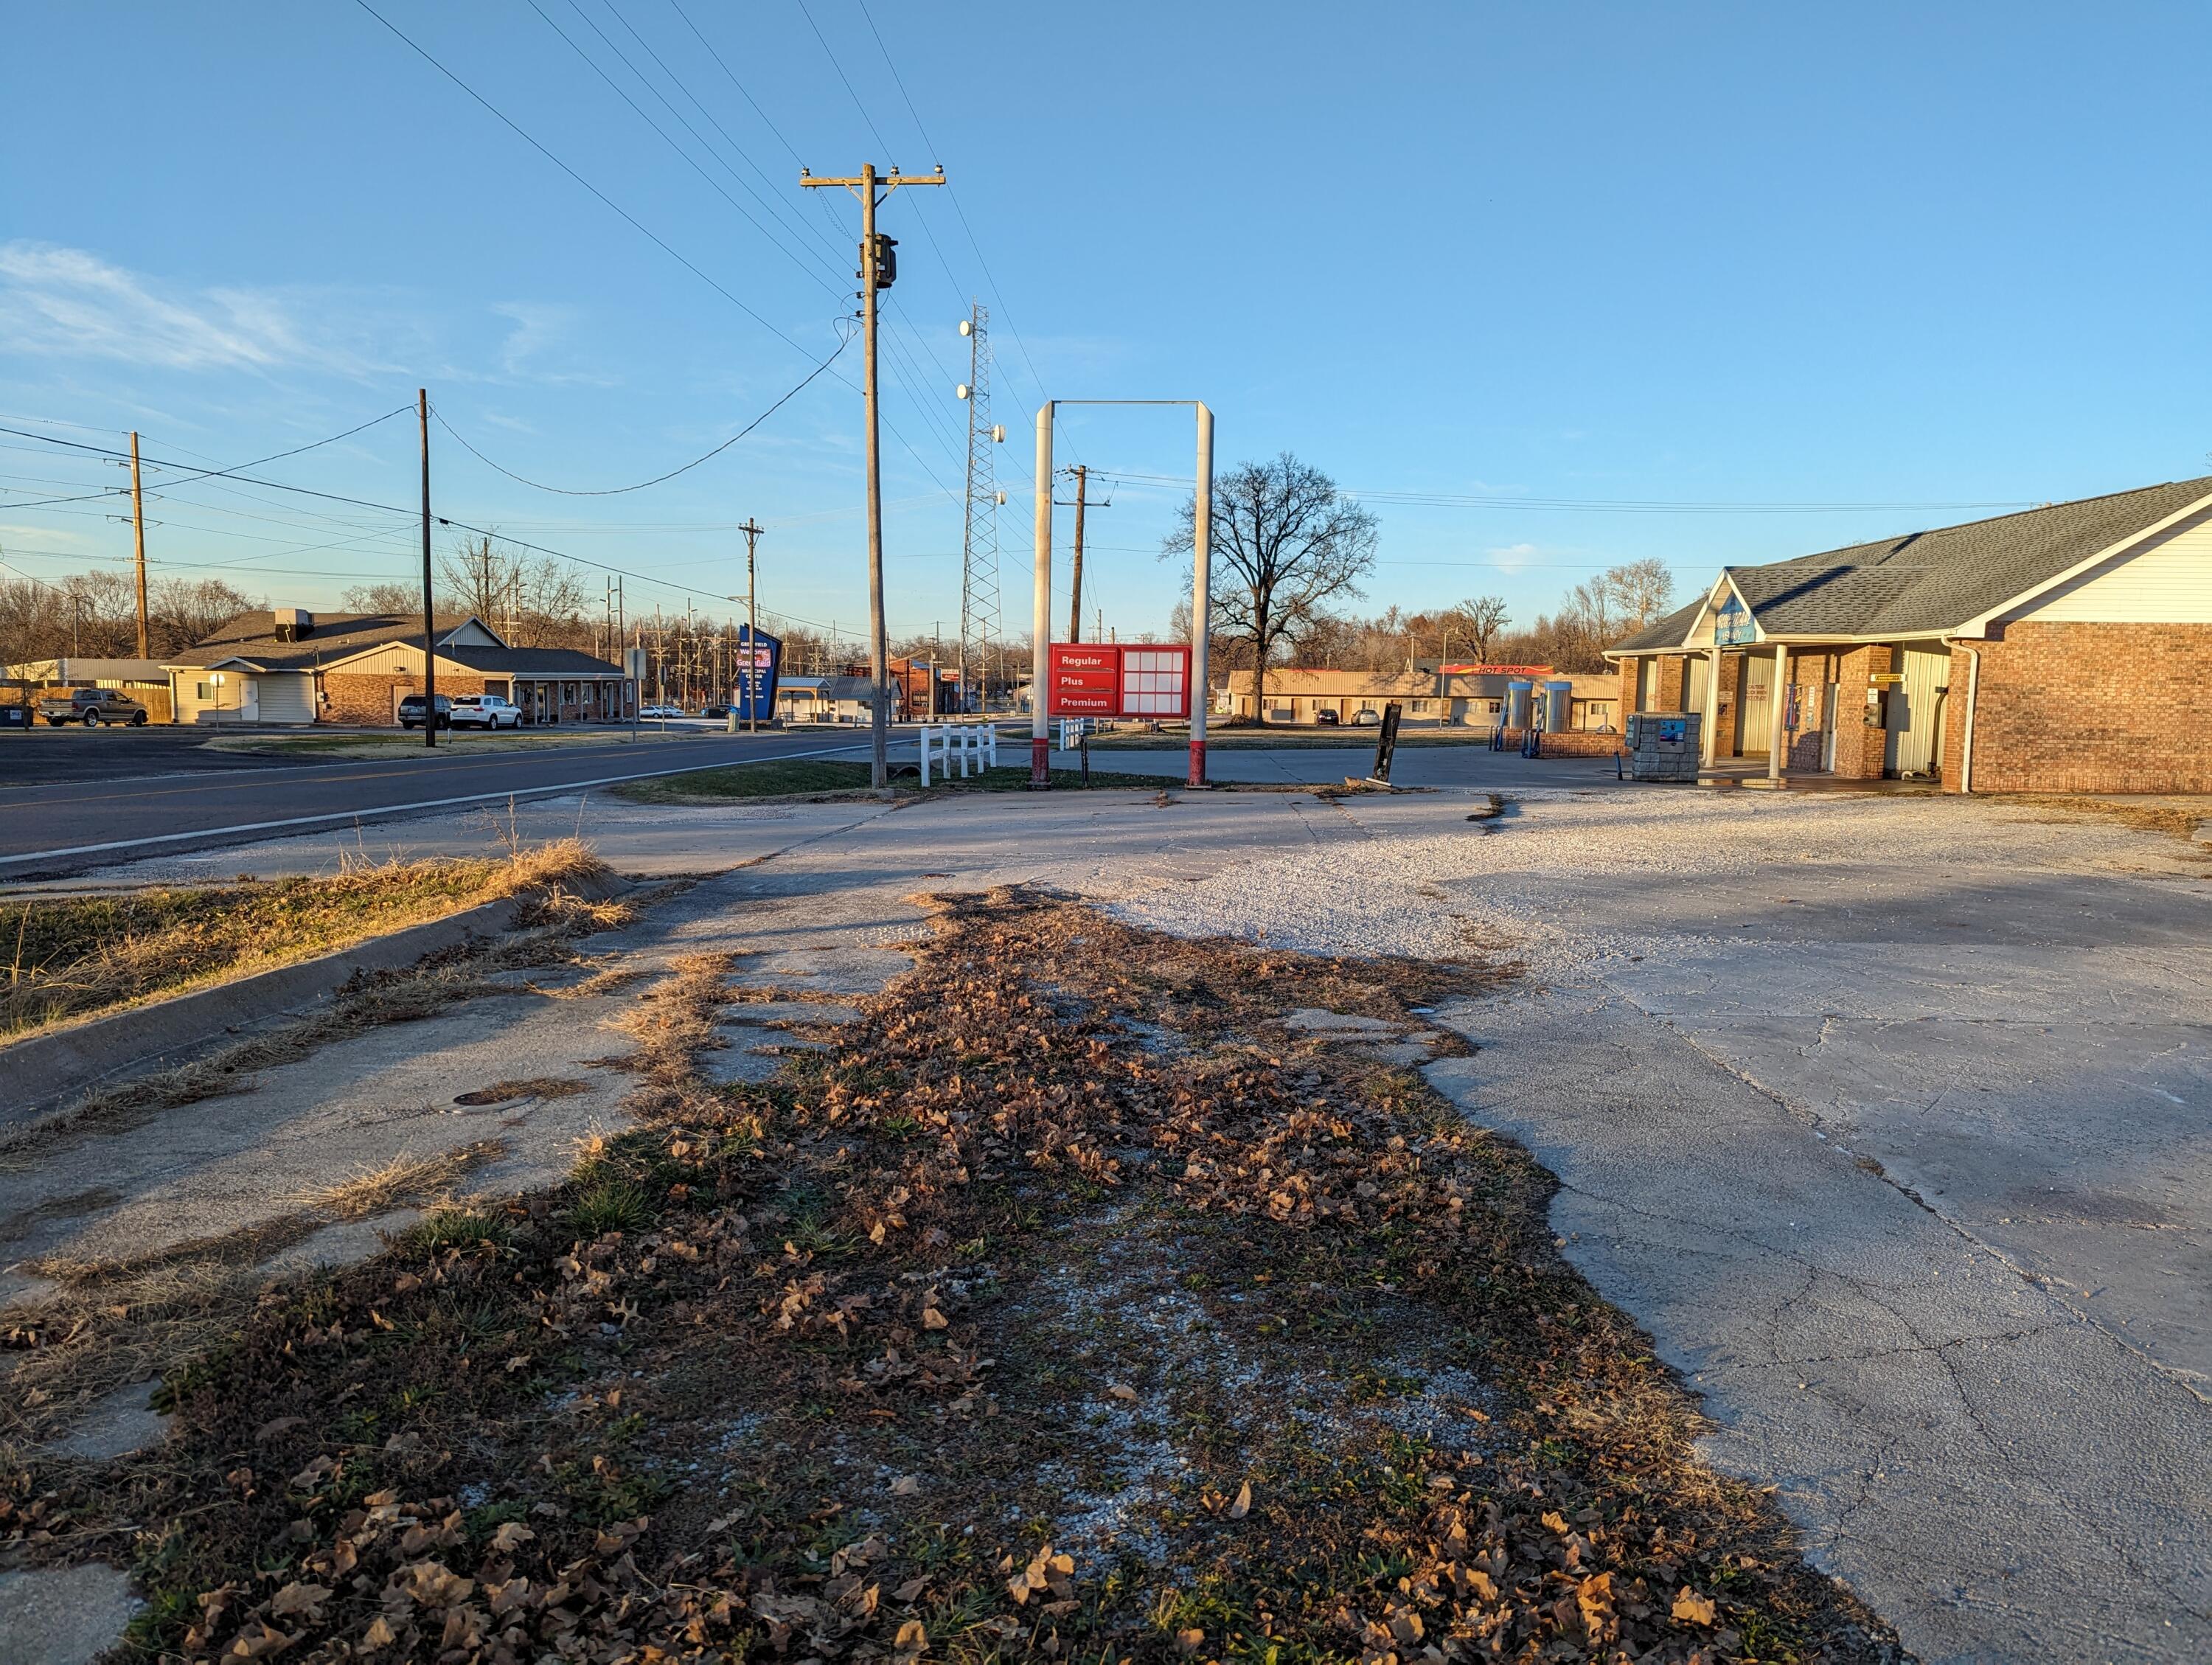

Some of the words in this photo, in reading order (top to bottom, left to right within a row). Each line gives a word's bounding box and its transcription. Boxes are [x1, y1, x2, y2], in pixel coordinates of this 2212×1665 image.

[1062, 656, 1102, 667] Regular
[1061, 676, 1084, 686] Plus
[1060, 697, 1107, 707] Premium
